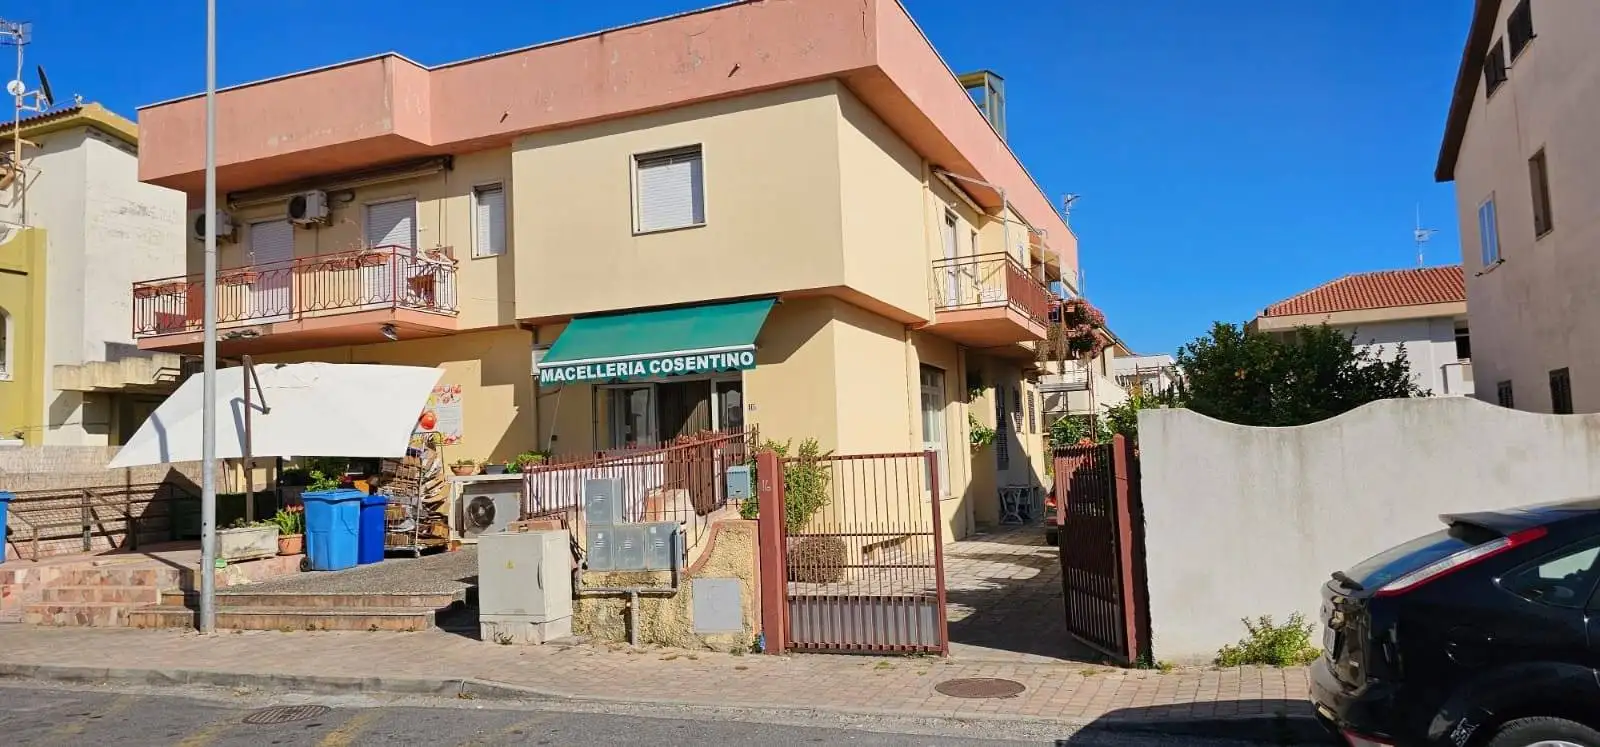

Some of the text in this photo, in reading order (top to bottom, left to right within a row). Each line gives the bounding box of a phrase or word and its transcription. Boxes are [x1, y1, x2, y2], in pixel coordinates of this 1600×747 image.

[541, 351, 754, 383] MACELLERIA COSENTINO
[762, 479, 771, 492] 16
